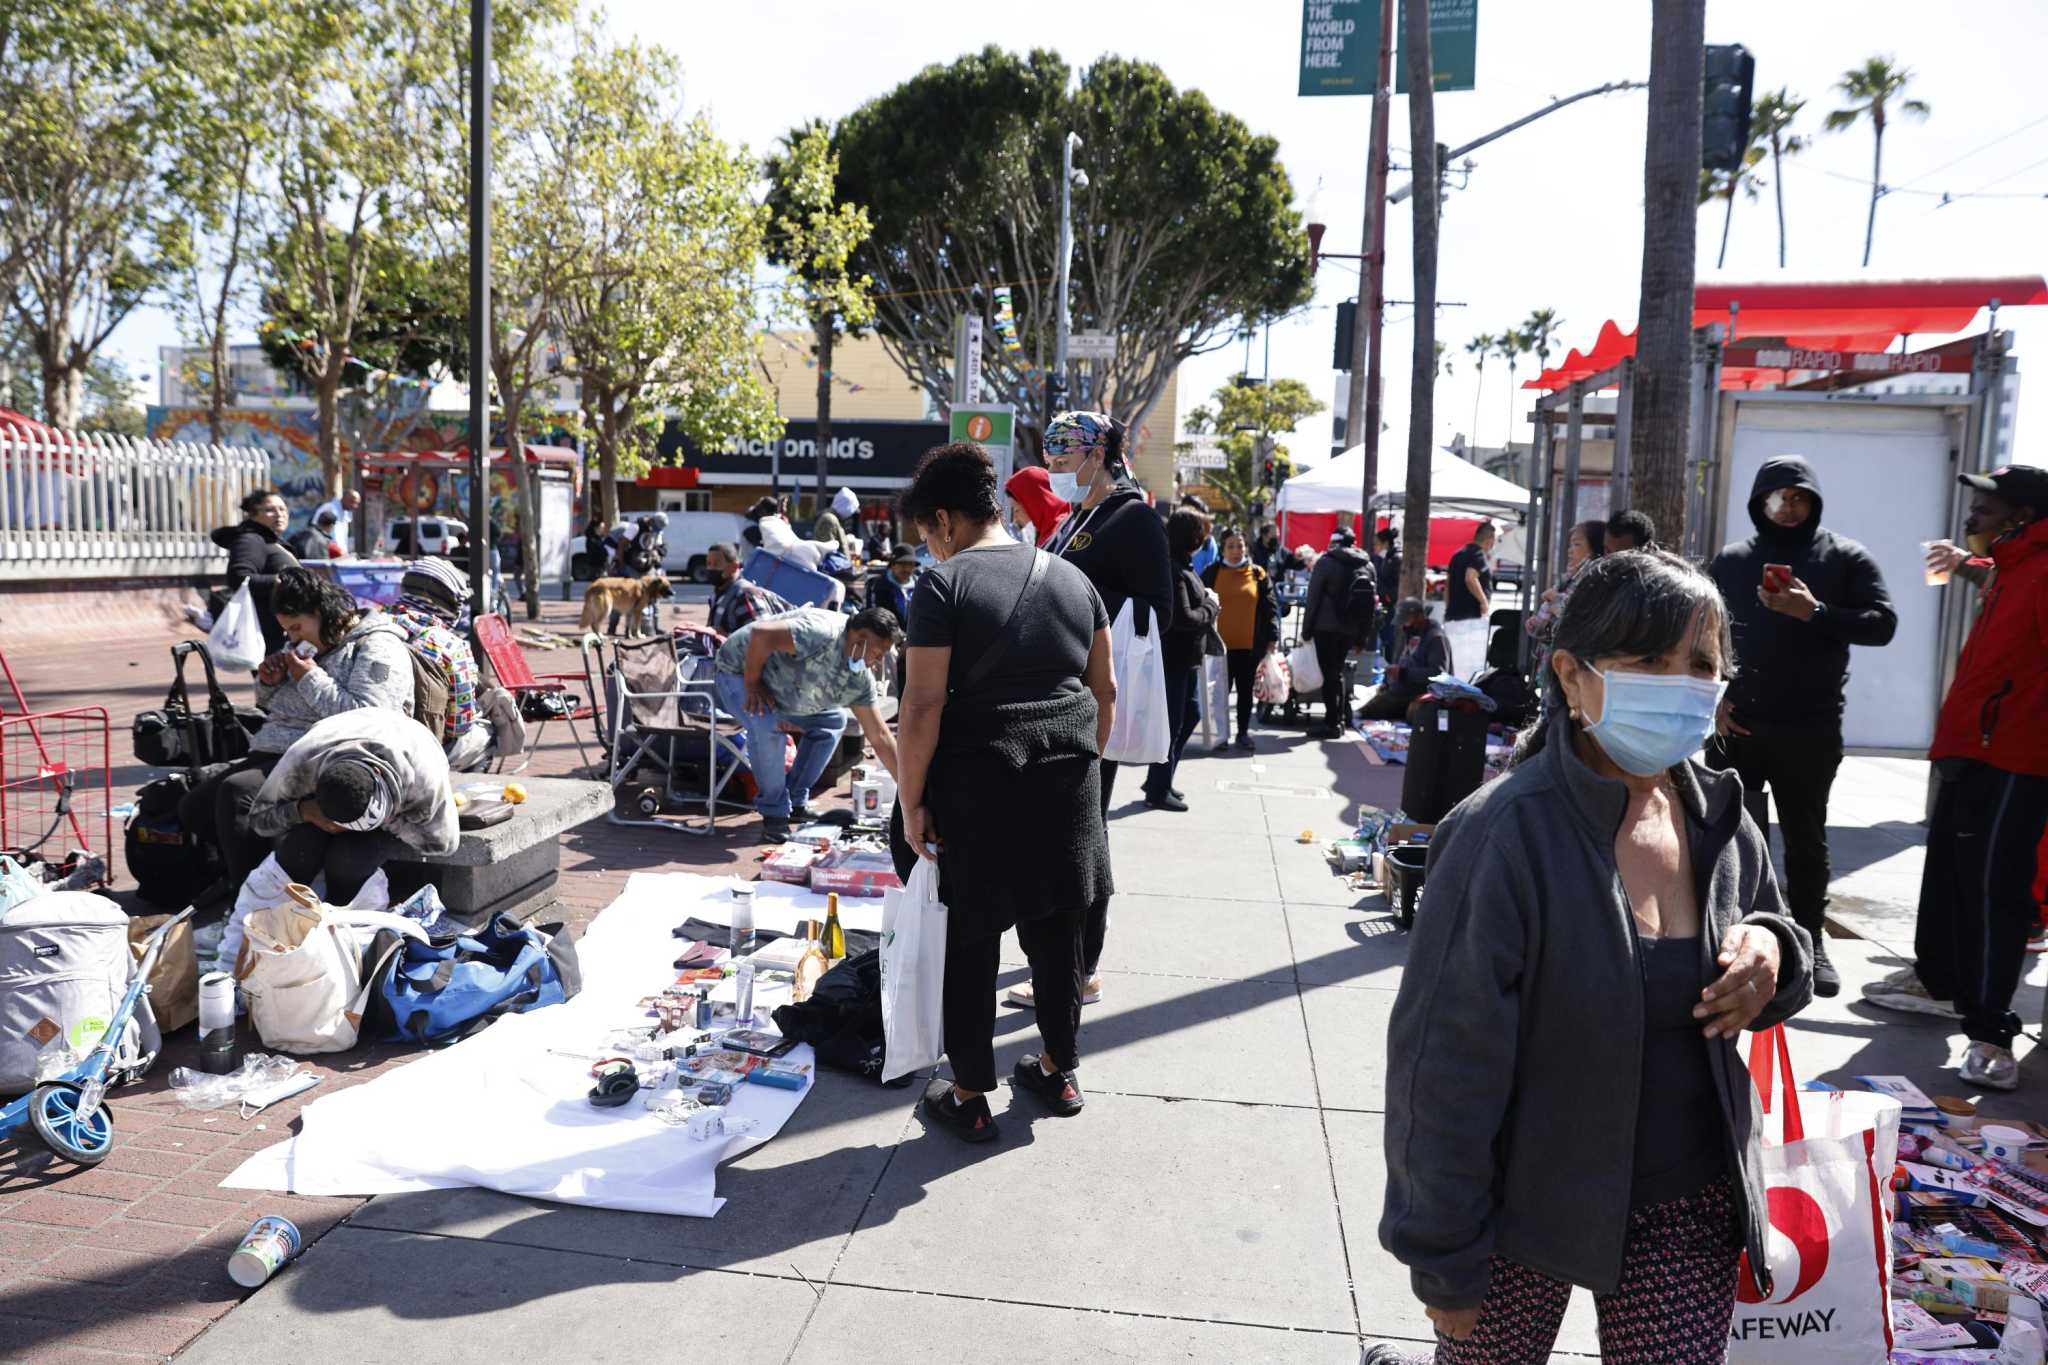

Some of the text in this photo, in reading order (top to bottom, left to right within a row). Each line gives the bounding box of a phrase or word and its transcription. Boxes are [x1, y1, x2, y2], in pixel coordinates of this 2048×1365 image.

[1308, 5, 1333, 20] THE
[1306, 19, 1355, 36] WORLD
[1306, 36, 1345, 52] FROM
[1305, 52, 1342, 68] HERE.
[1791, 350, 1841, 369] RAPID
[1888, 353, 1941, 372] RAPID
[722, 435, 875, 459] Mconld's
[1731, 1308, 1836, 1340] AFEWAY
